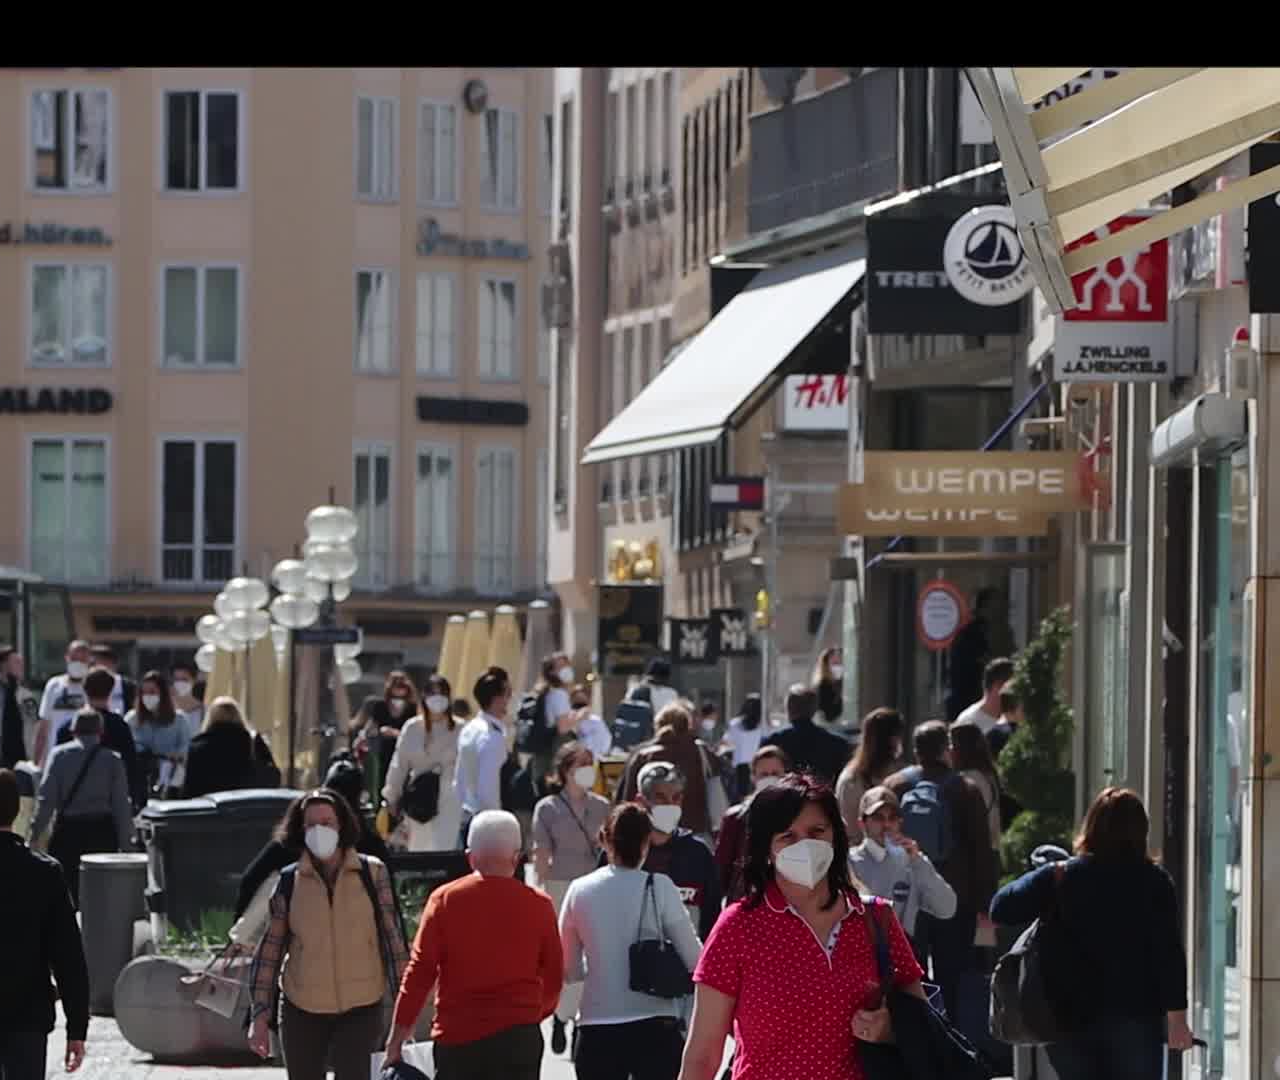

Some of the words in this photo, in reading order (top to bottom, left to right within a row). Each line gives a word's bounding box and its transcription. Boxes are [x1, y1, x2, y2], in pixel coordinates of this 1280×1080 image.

[875, 271, 951, 288] TRET
[1079, 346, 1151, 359] ZWILLING
[894, 468, 1065, 494] WEMPE
